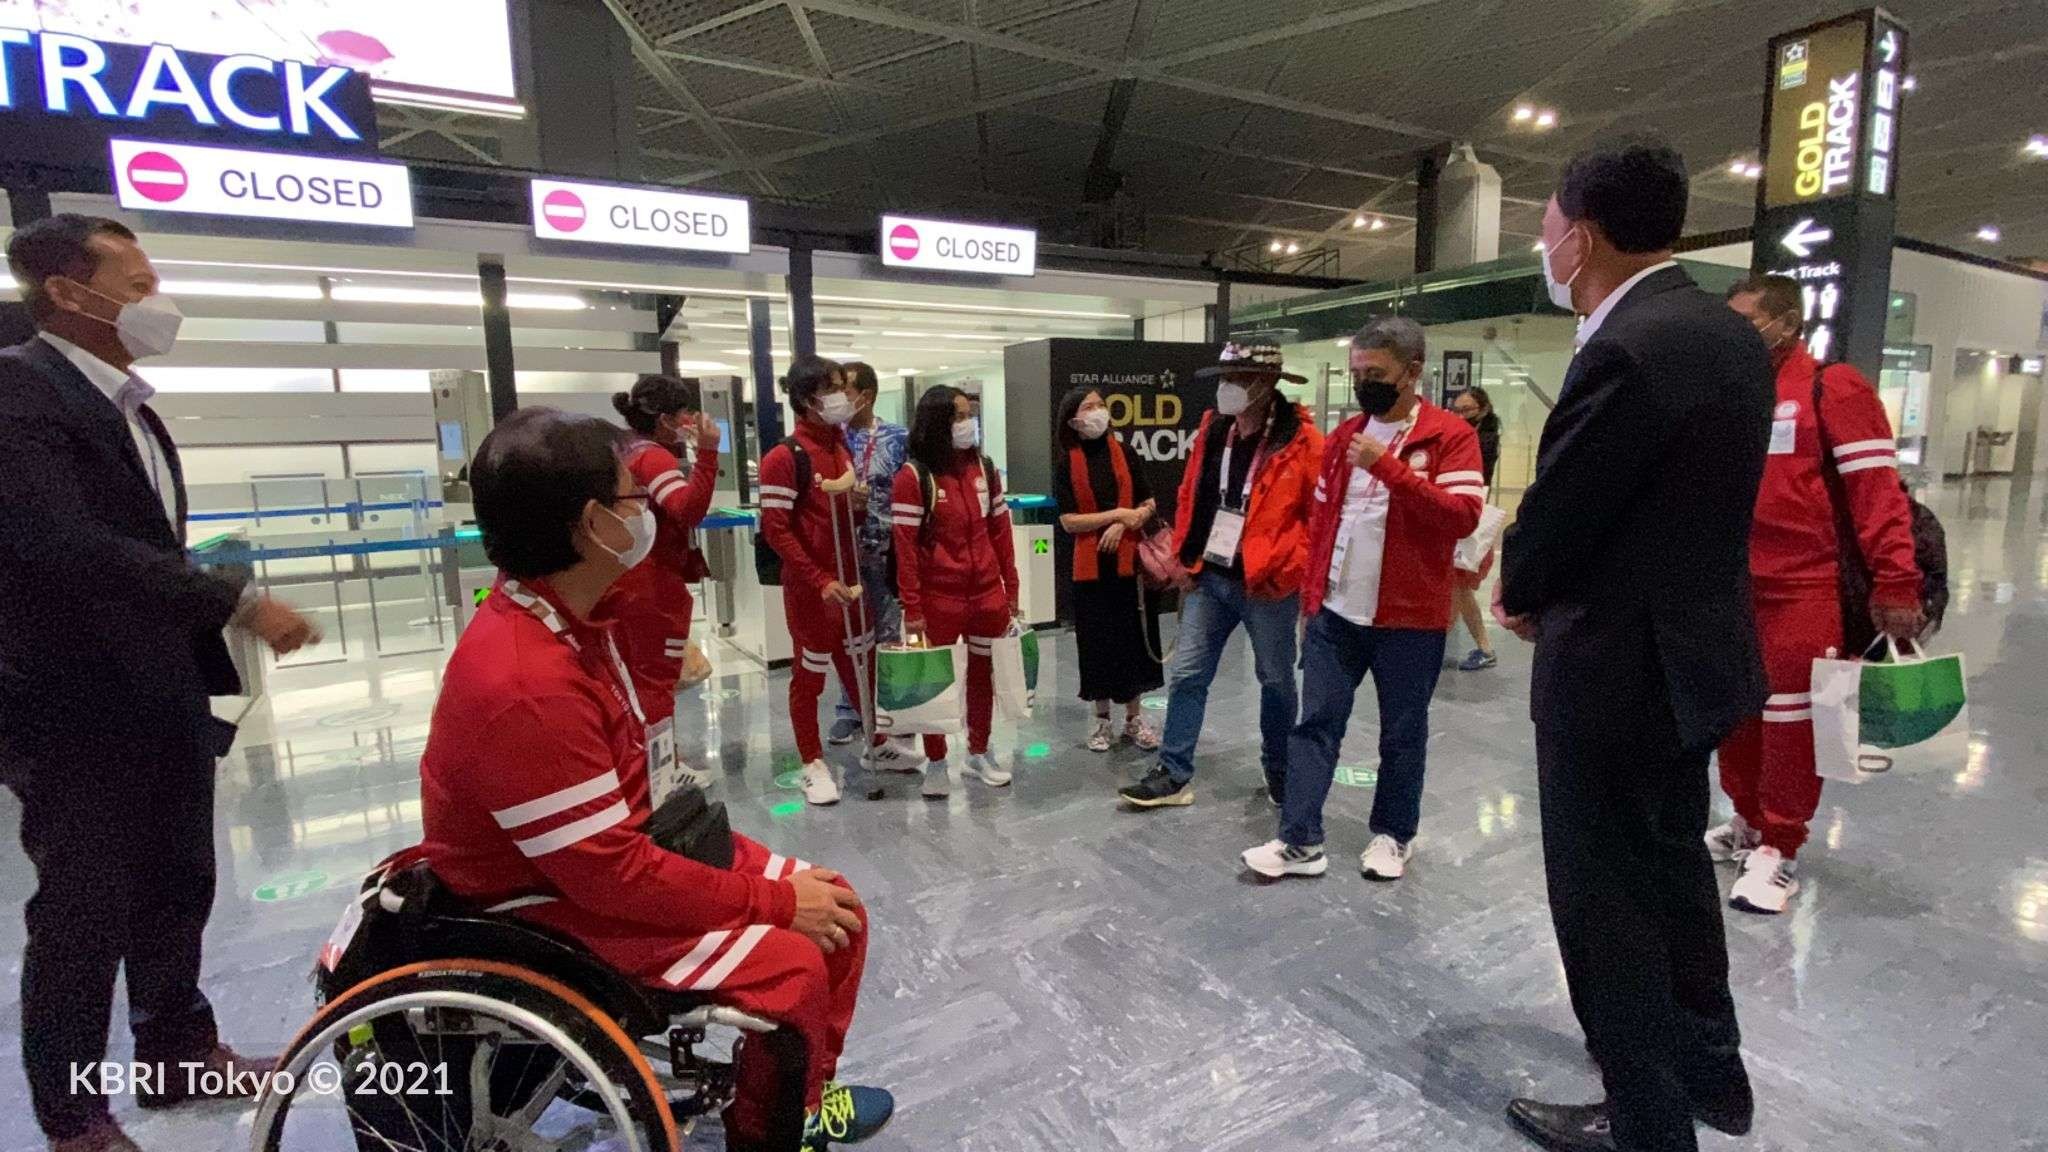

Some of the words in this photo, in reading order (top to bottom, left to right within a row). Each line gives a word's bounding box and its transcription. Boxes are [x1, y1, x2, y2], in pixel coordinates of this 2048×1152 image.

[1795, 102, 1826, 196] GOLD
[1822, 72, 1856, 194] TRACK
[219, 169, 383, 209] CLOSED
[609, 205, 728, 237] CLOSED
[936, 236, 1021, 263] CLOSED
[1799, 262, 1840, 279] Track
[1070, 373, 1098, 384] STAR
[1102, 373, 1154, 385] ALLIANCE
[1105, 394, 1182, 427] OLD
